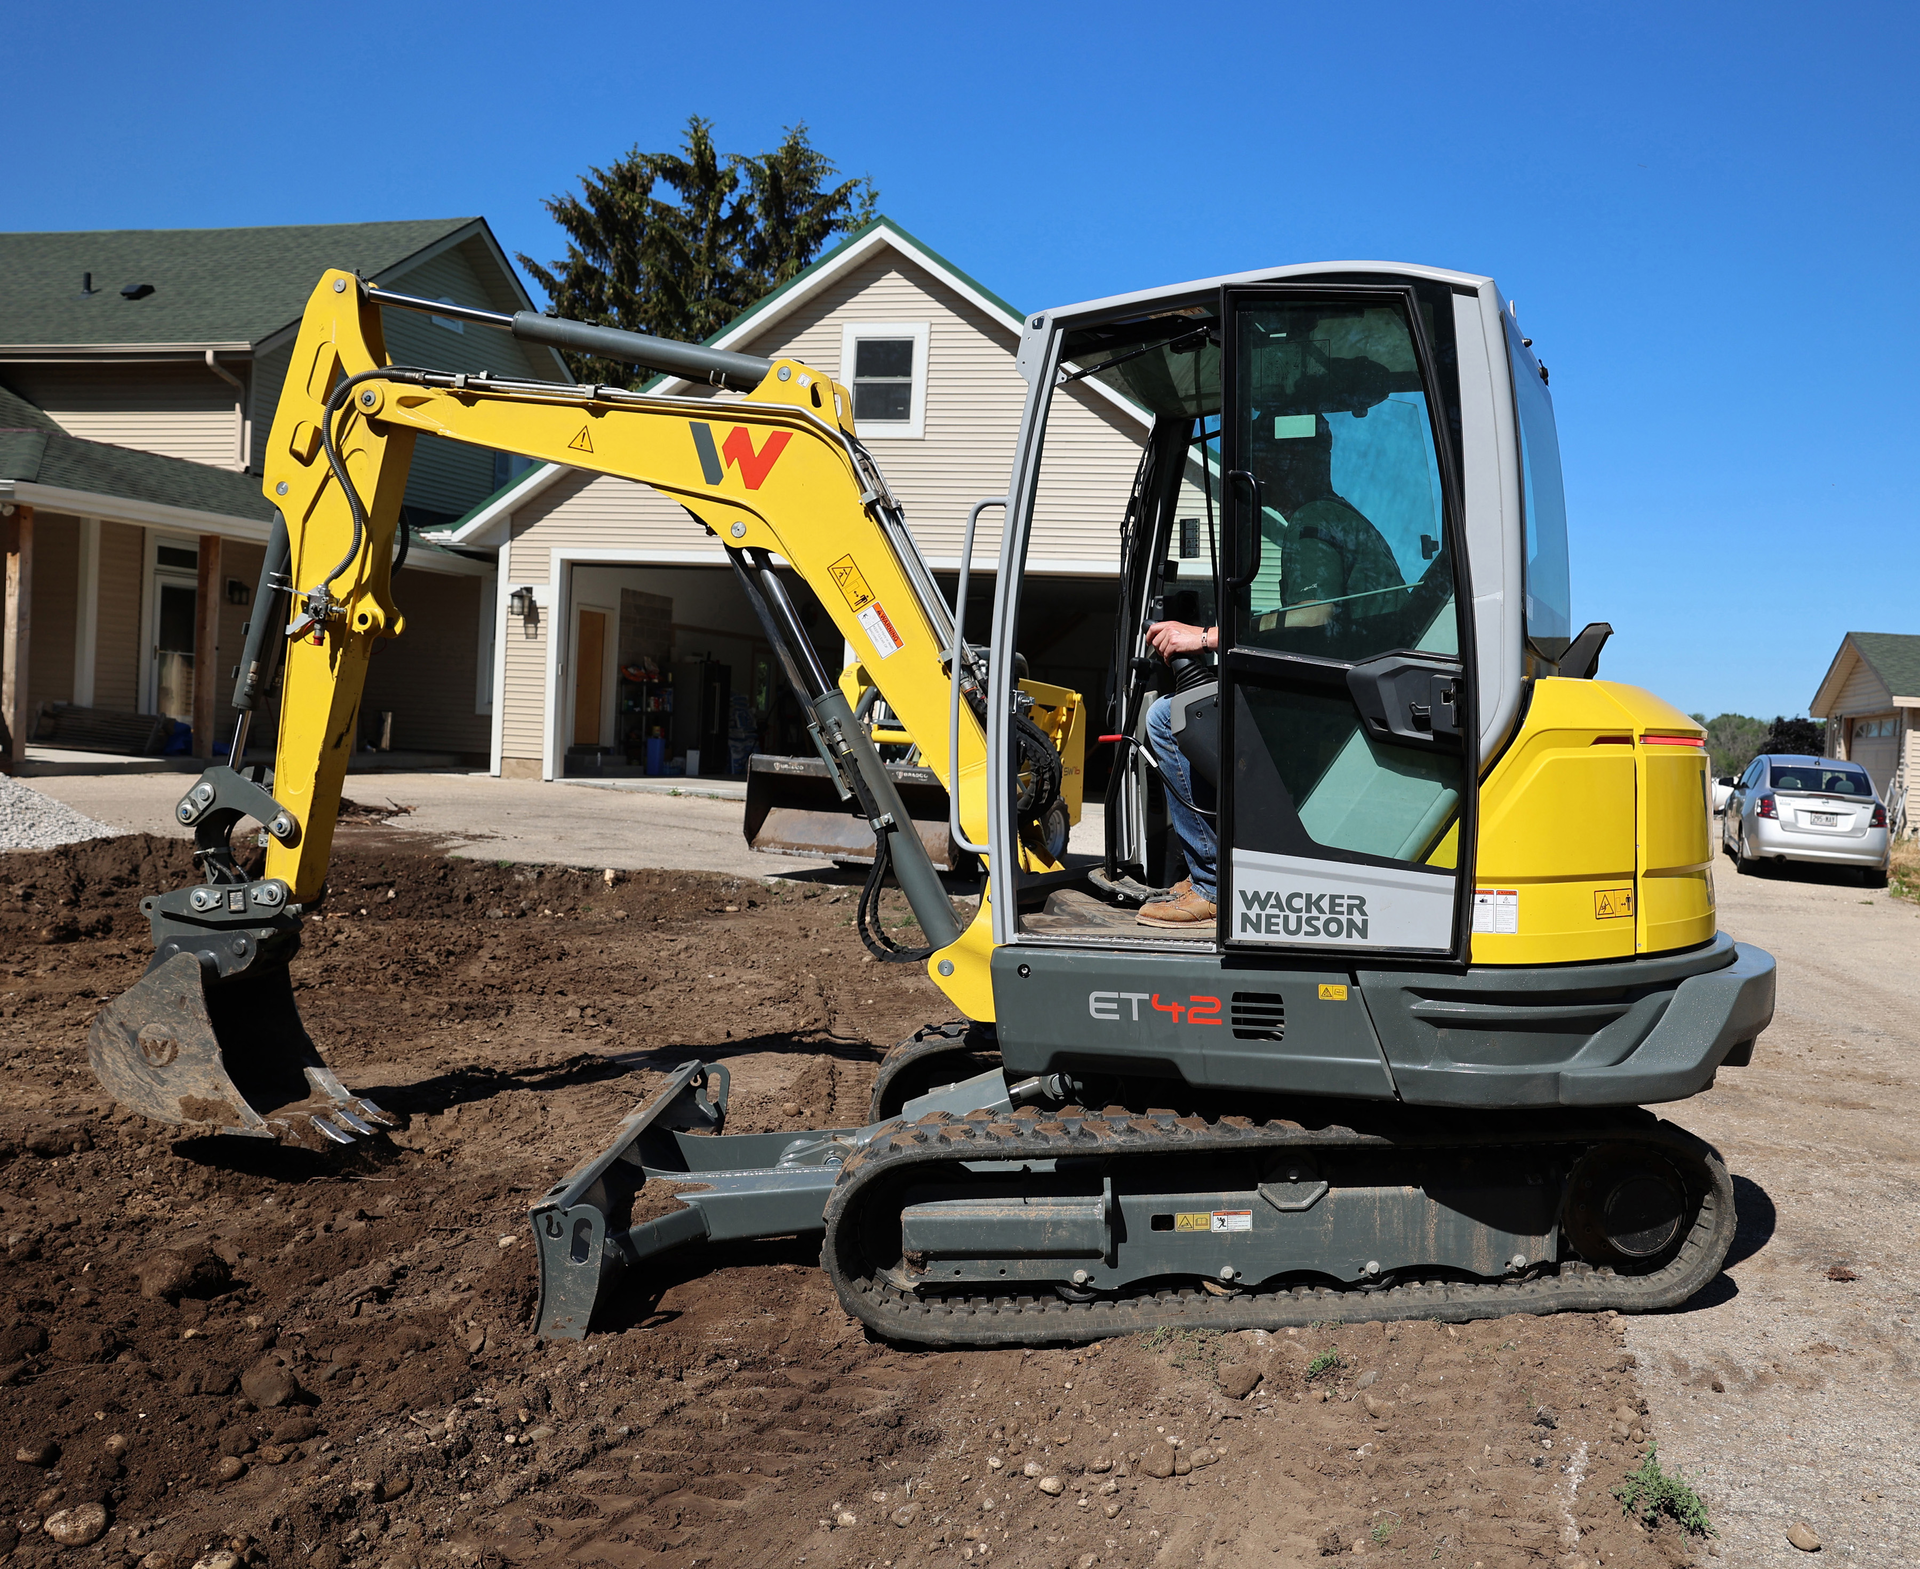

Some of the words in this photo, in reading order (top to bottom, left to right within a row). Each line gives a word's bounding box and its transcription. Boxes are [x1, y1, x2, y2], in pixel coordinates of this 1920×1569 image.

[880, 614, 899, 642] WARNING
[1238, 890, 1367, 917] WACKER
[1240, 912, 1369, 939] NEUSON
[1088, 991, 1222, 1026] ET42
